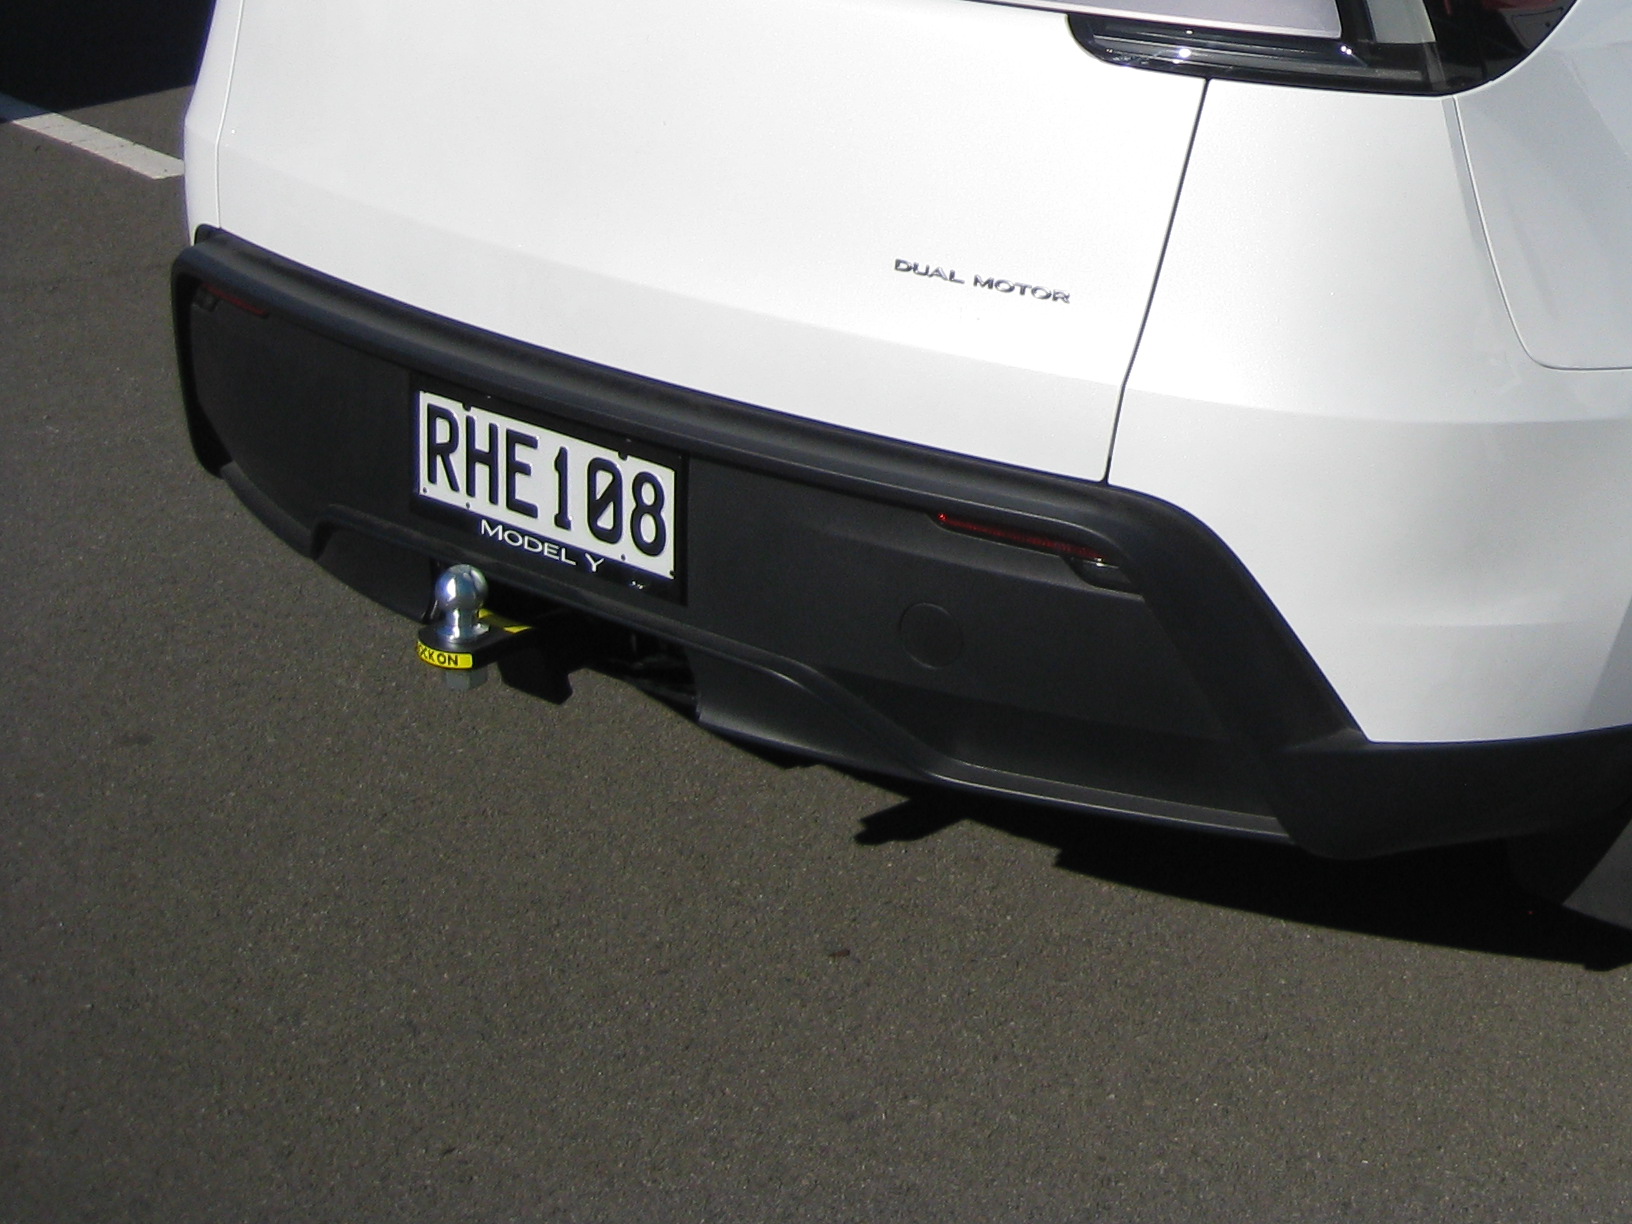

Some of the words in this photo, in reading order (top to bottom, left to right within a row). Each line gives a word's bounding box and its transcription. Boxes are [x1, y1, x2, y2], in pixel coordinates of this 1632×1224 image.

[893, 258, 966, 285] DUAL
[972, 274, 1071, 304] MOTOR
[426, 402, 667, 557] RHE108
[480, 519, 577, 566] MODEL
[584, 552, 606, 573] Y
